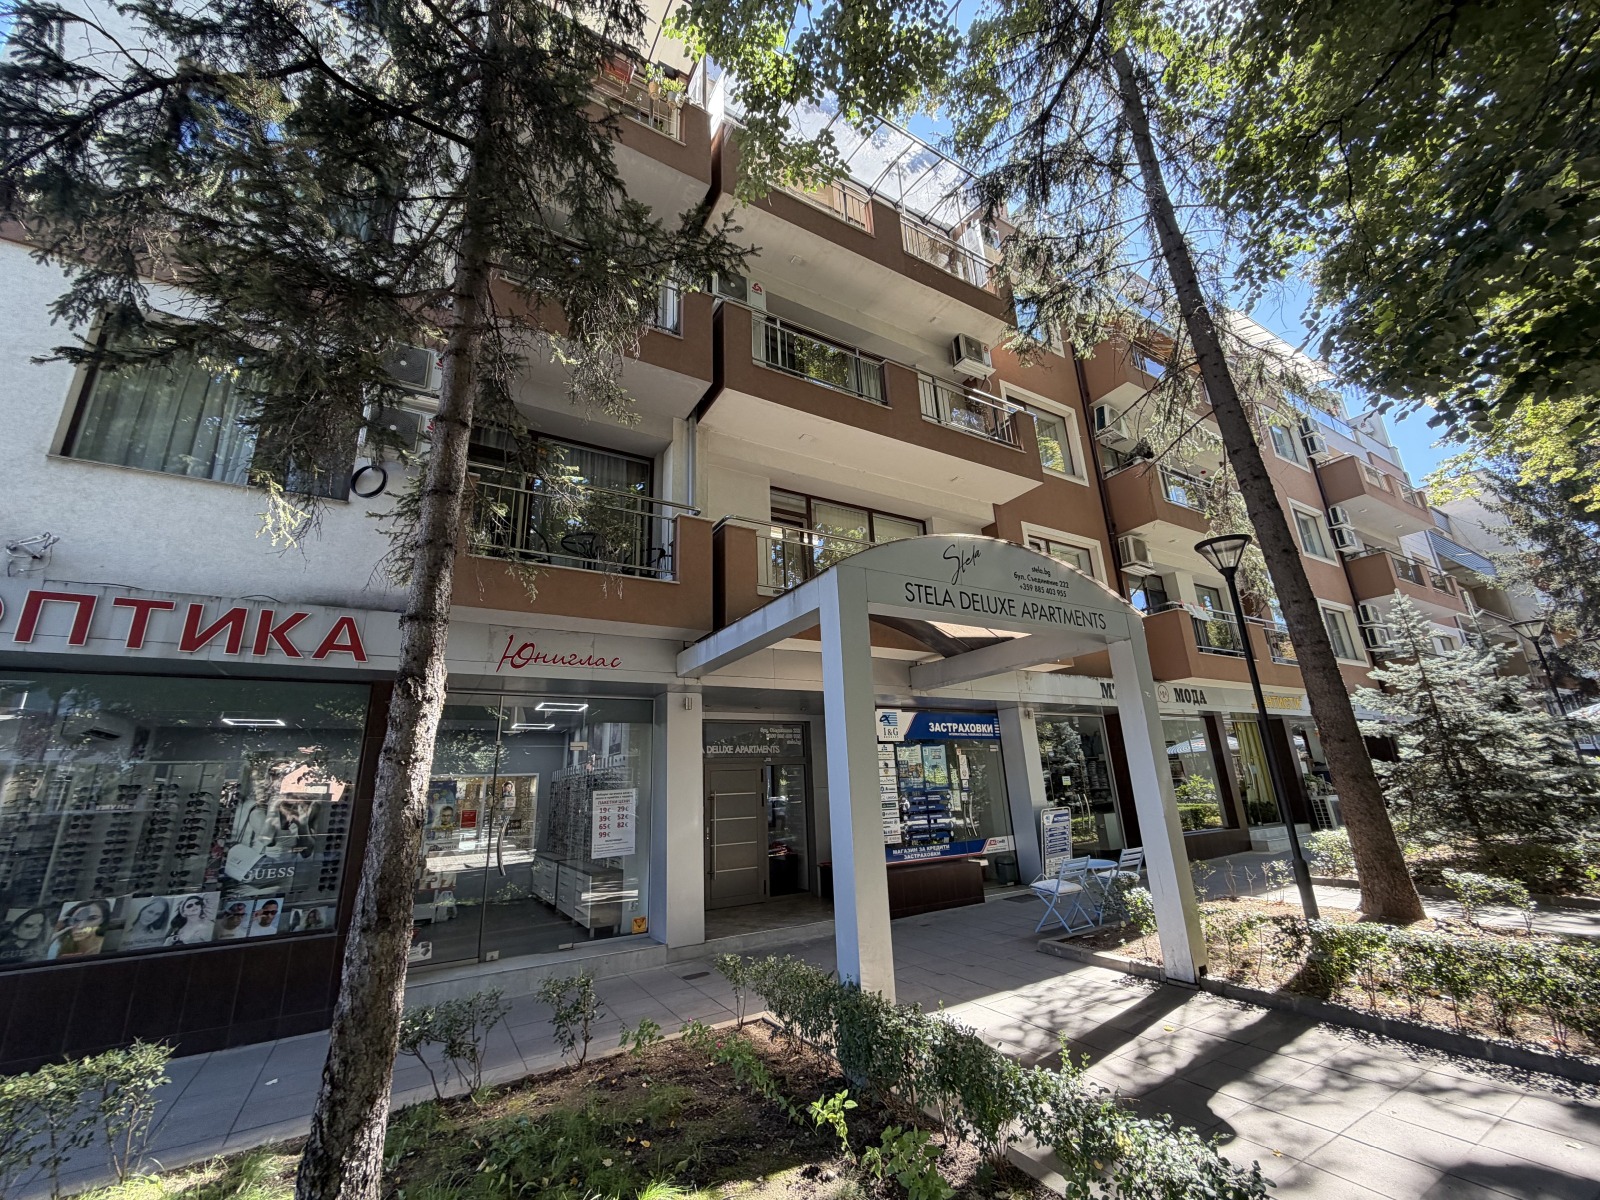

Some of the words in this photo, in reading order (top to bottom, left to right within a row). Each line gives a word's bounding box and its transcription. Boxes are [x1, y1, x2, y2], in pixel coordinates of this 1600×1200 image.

[1031, 566, 1051, 577] stela.bg
[1013, 571, 1026, 581] бул.
[1026, 574, 1059, 586] Съединение
[1059, 580, 1069, 589] 222
[1019, 584, 1034, 592] +359
[1034, 585, 1045, 594] 885
[1045, 587, 1056, 595] 403
[1056, 588, 1067, 598] 955
[904, 582, 956, 609] STELA
[959, 591, 1017, 617] DELUXE
[1021, 602, 1107, 630] APARTMENTS
[0, 590, 369, 663] ПТИКА
[496, 634, 622, 673] Юниглас
[1173, 687, 1208, 706] МОДА
[928, 722, 993, 733] ЗАСТРАХОВКИ
[706, 745, 734, 754] DELUXE
[735, 745, 780, 754] APARTMENTS
[903, 851, 941, 860] ЗАСТРАХОВКИ
[926, 844, 950, 852] КРЕДИТИ
[242, 866, 295, 882] GUESS
